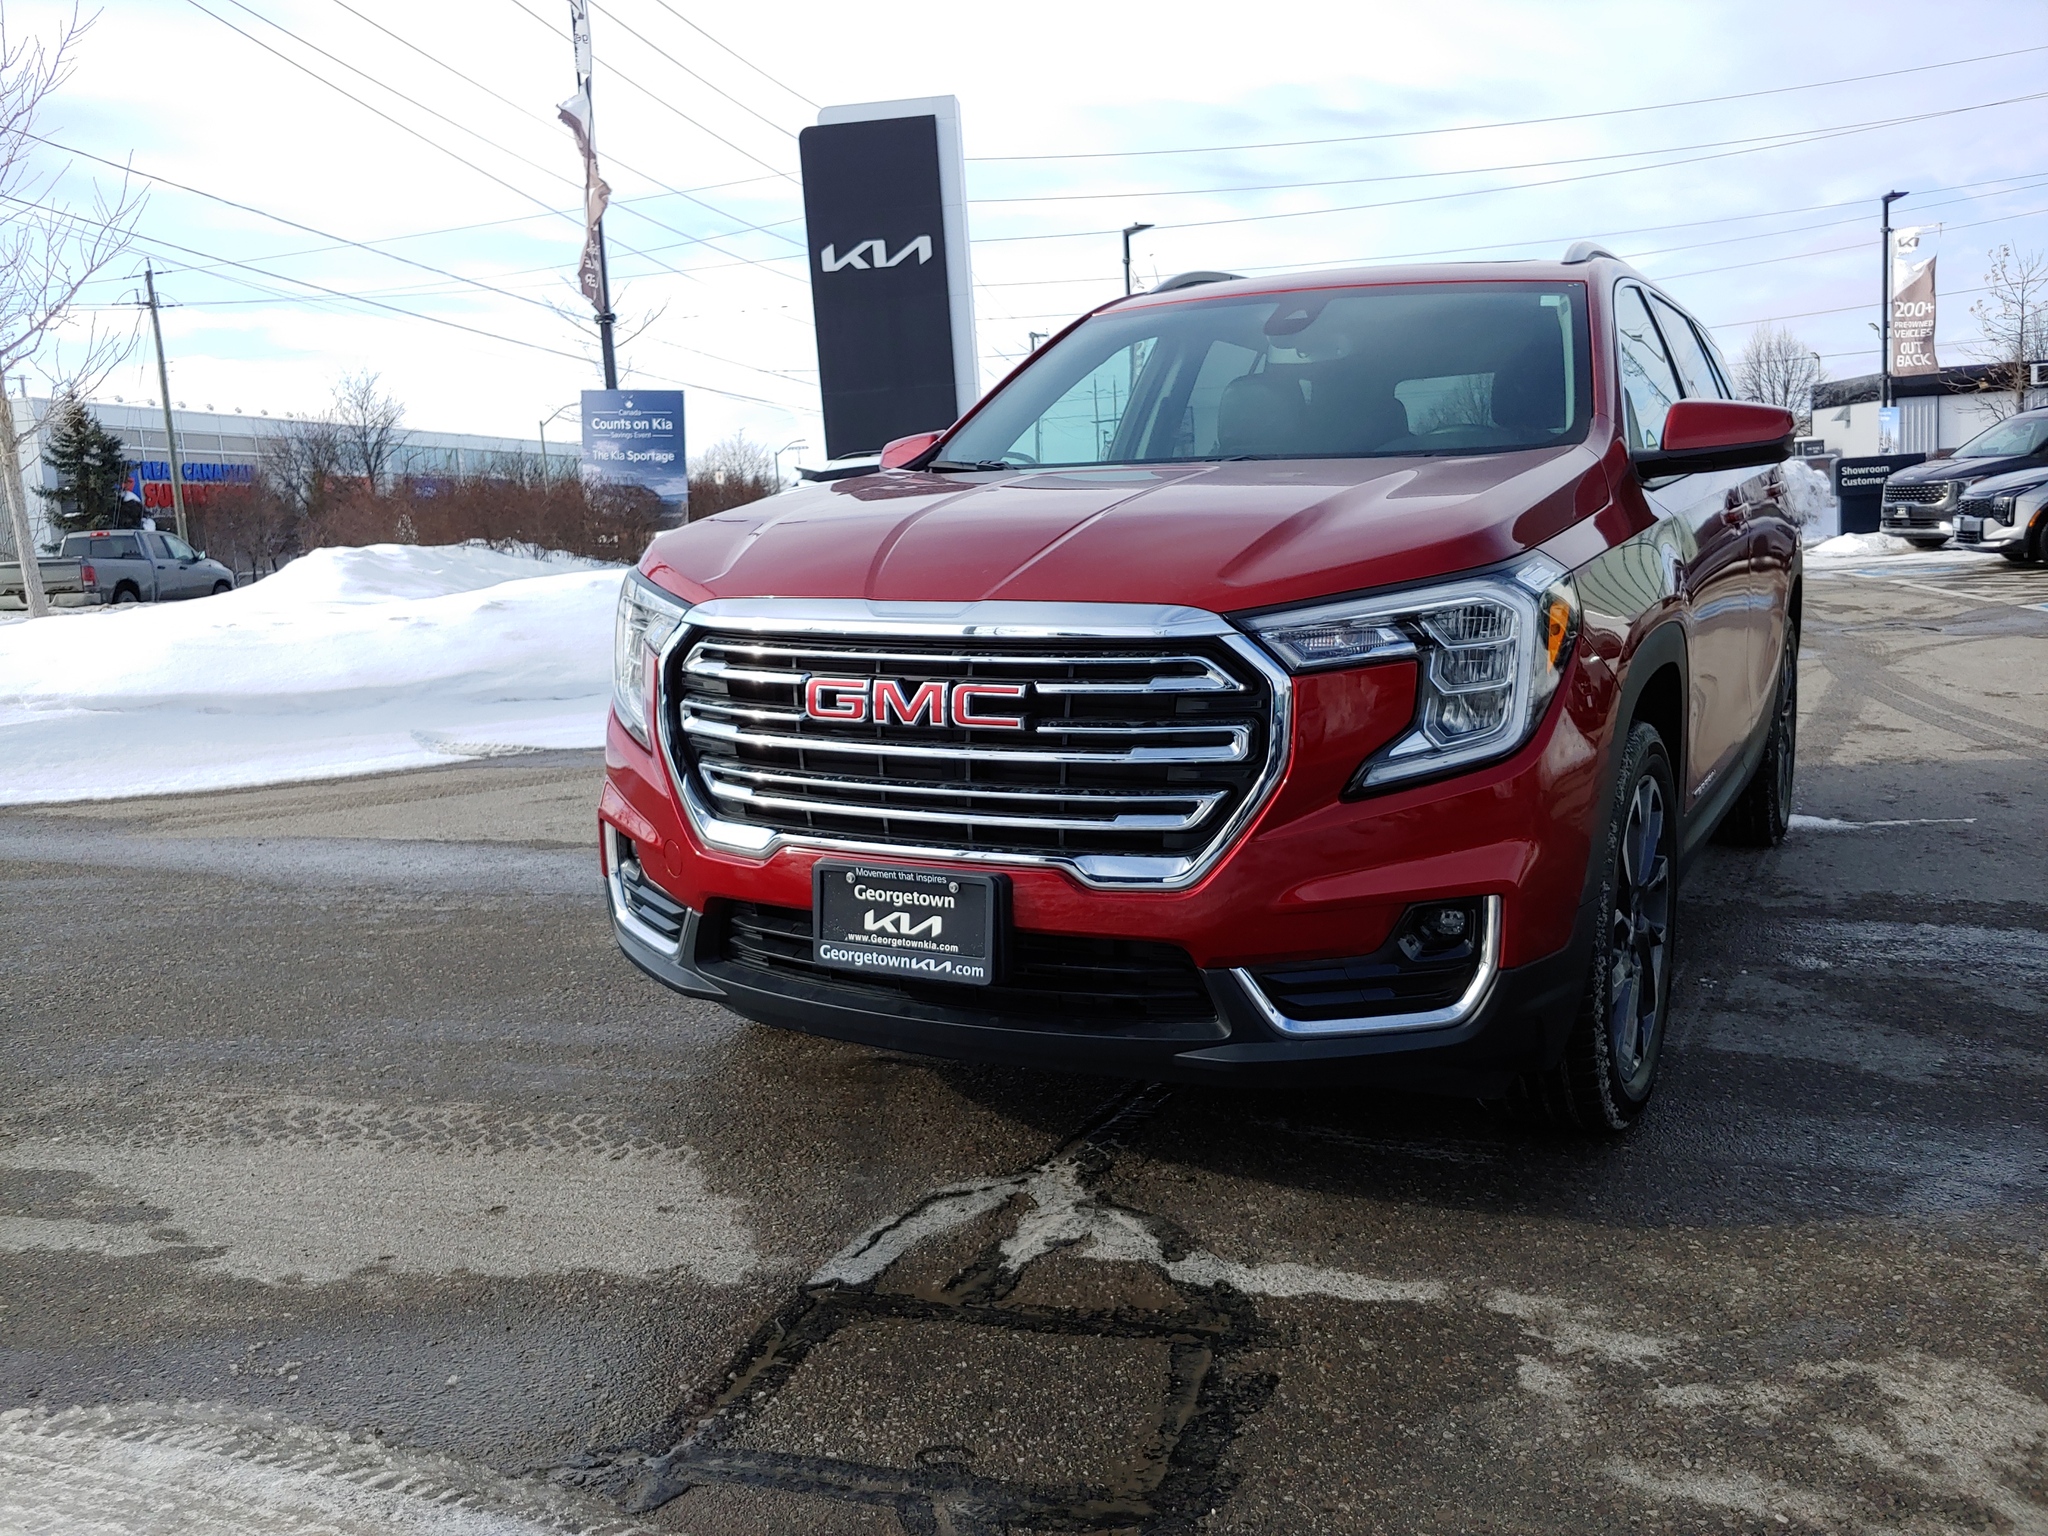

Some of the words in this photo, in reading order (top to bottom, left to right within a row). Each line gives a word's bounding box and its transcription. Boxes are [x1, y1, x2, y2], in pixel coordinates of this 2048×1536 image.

[821, 236, 933, 272] KIA
[1894, 301, 1934, 317] 200+
[1900, 341, 1924, 354] OUT
[1896, 353, 1932, 367] BACK
[591, 418, 632, 430] Counts
[633, 420, 649, 430] on
[652, 418, 673, 430] Kia
[593, 450, 609, 460] The
[611, 451, 625, 460] Kia
[627, 450, 675, 463] Sportage
[140, 461, 174, 481] REA
[1841, 465, 1890, 476] Showroom
[1841, 477, 1885, 486] Customer
[805, 677, 1026, 731] GMC
[855, 867, 897, 880] Movement
[898, 872, 914, 881] that
[916, 874, 947, 884] inspires
[854, 884, 955, 909] Georgetown
[864, 909, 942, 938] KIA
[848, 933, 959, 953] www.Georgetownkia.com
